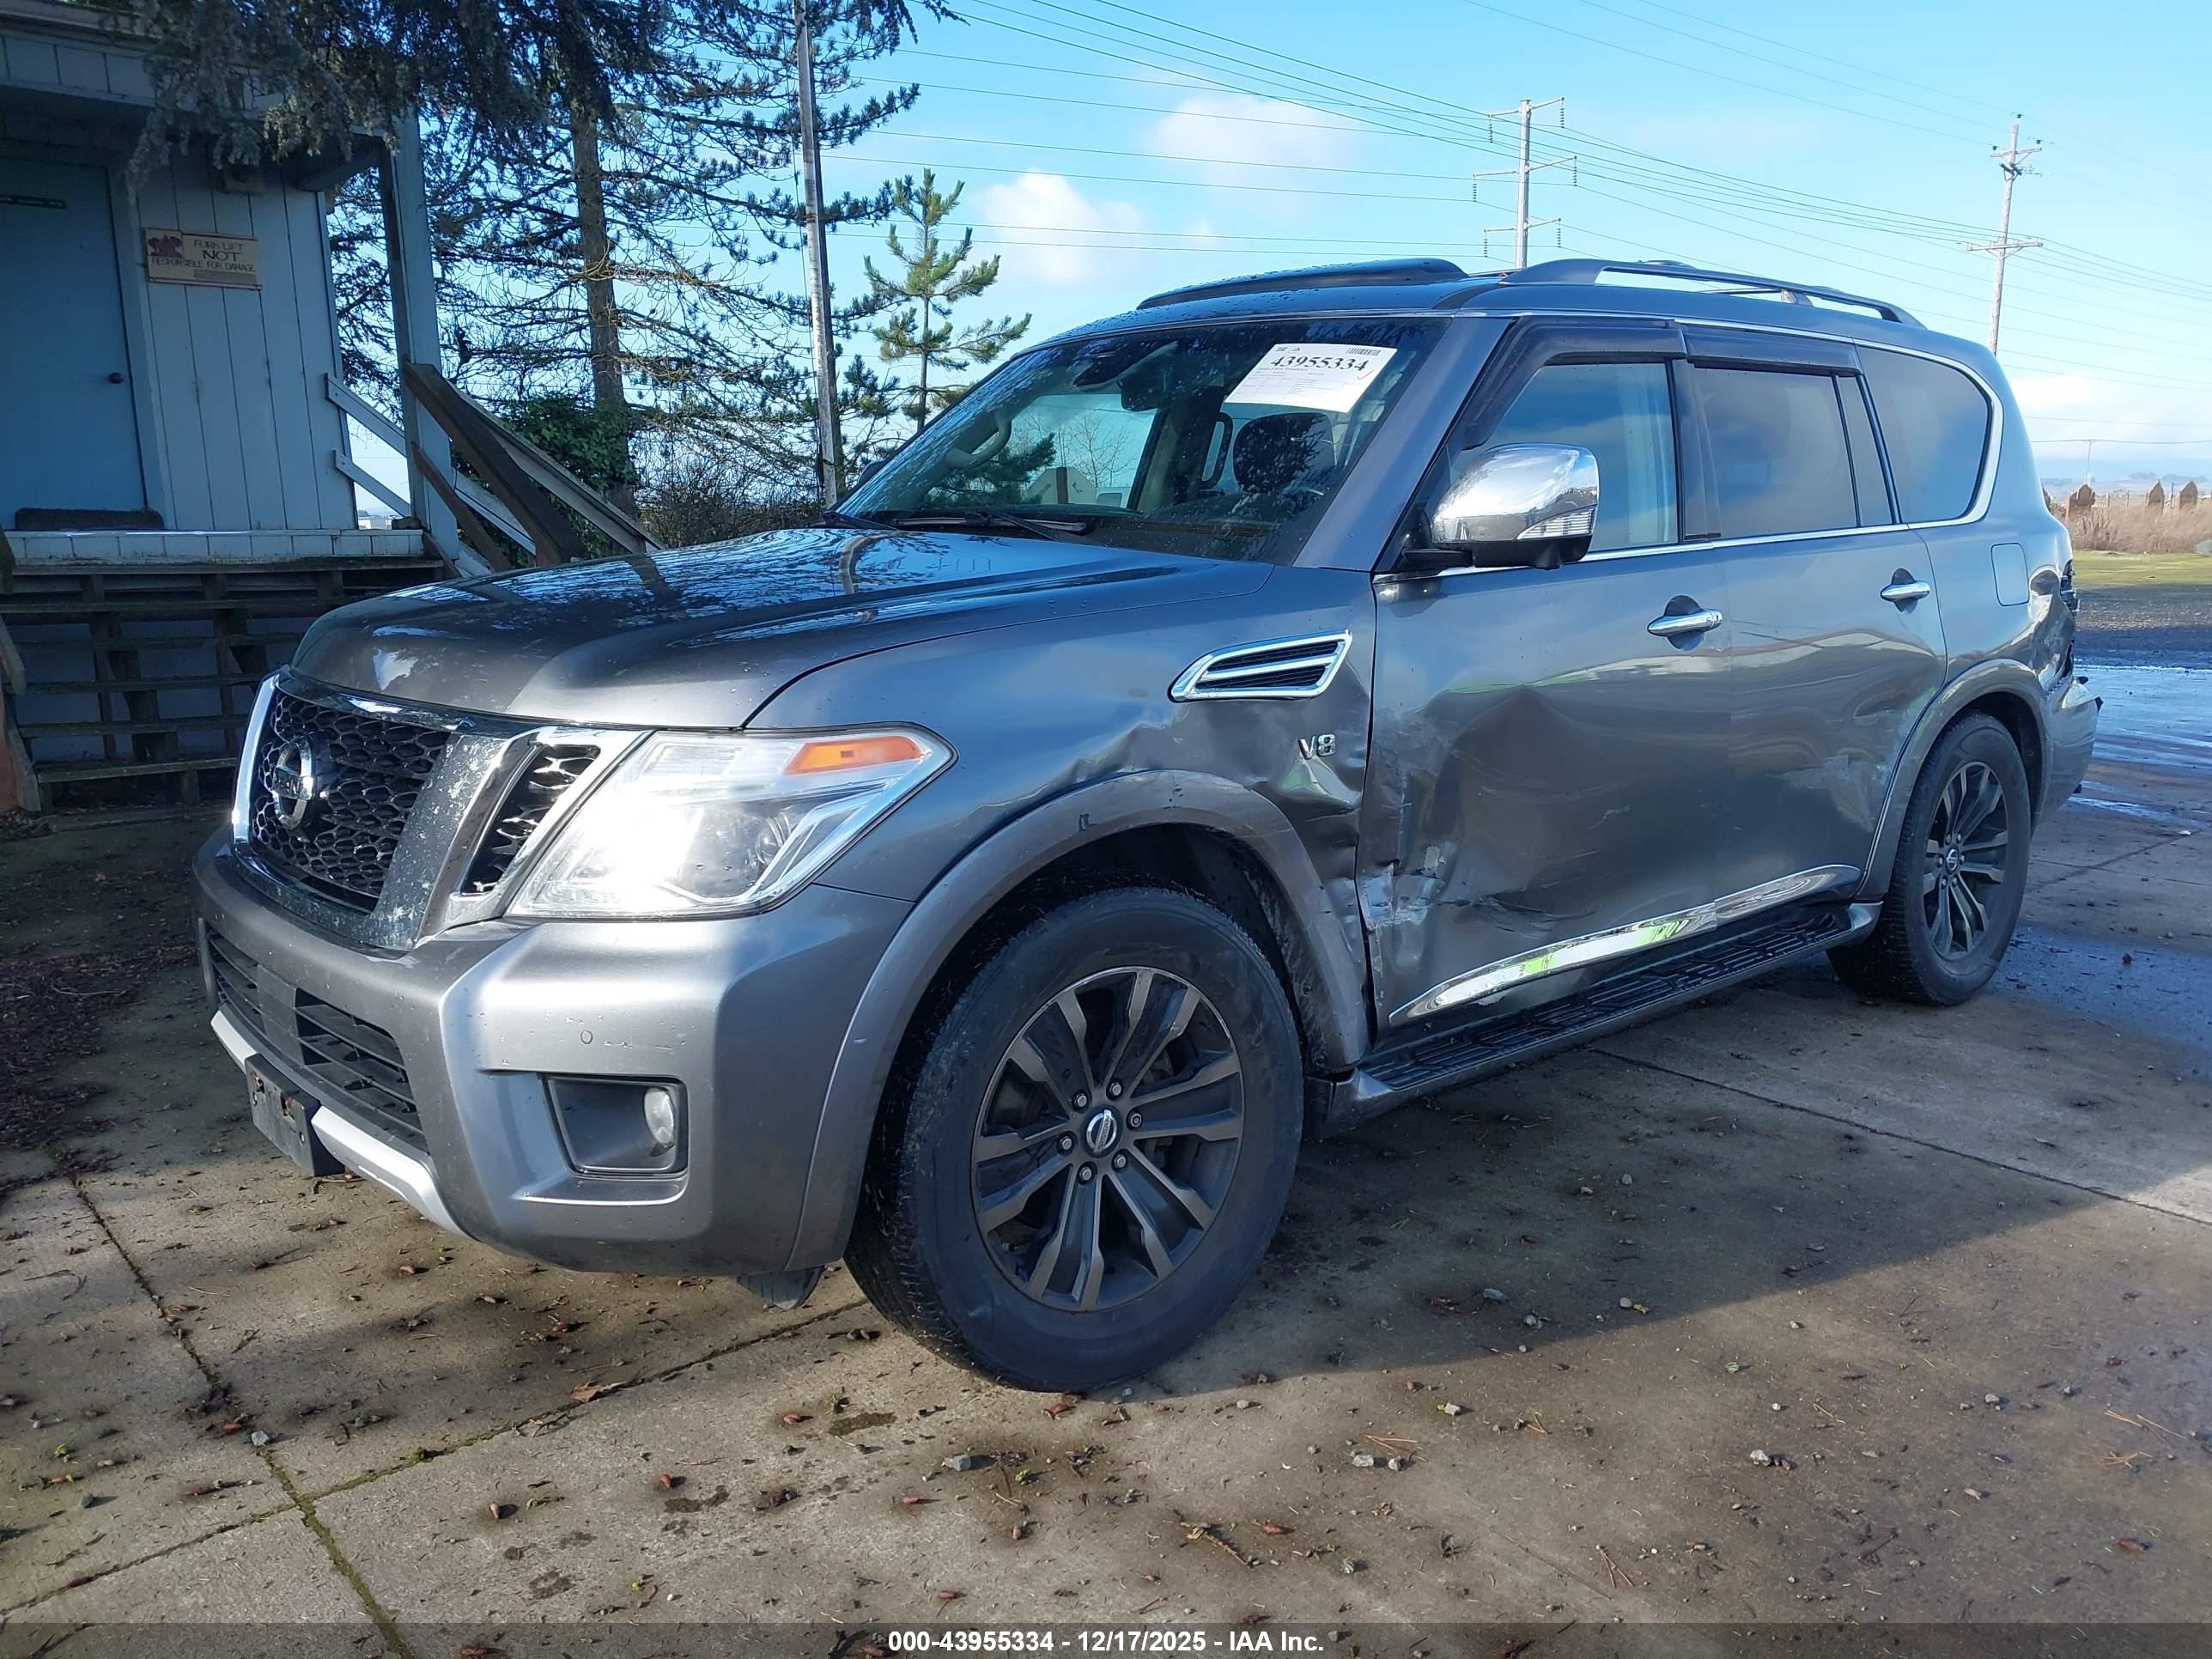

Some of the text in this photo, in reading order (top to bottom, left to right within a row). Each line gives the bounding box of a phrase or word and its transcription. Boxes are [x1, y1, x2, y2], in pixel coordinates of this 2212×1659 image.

[203, 250, 242, 261] NOT
[1271, 356, 1369, 371] 43955334
[1297, 733, 1335, 760] V8
[1098, 1115, 1110, 1149] NISSAN
